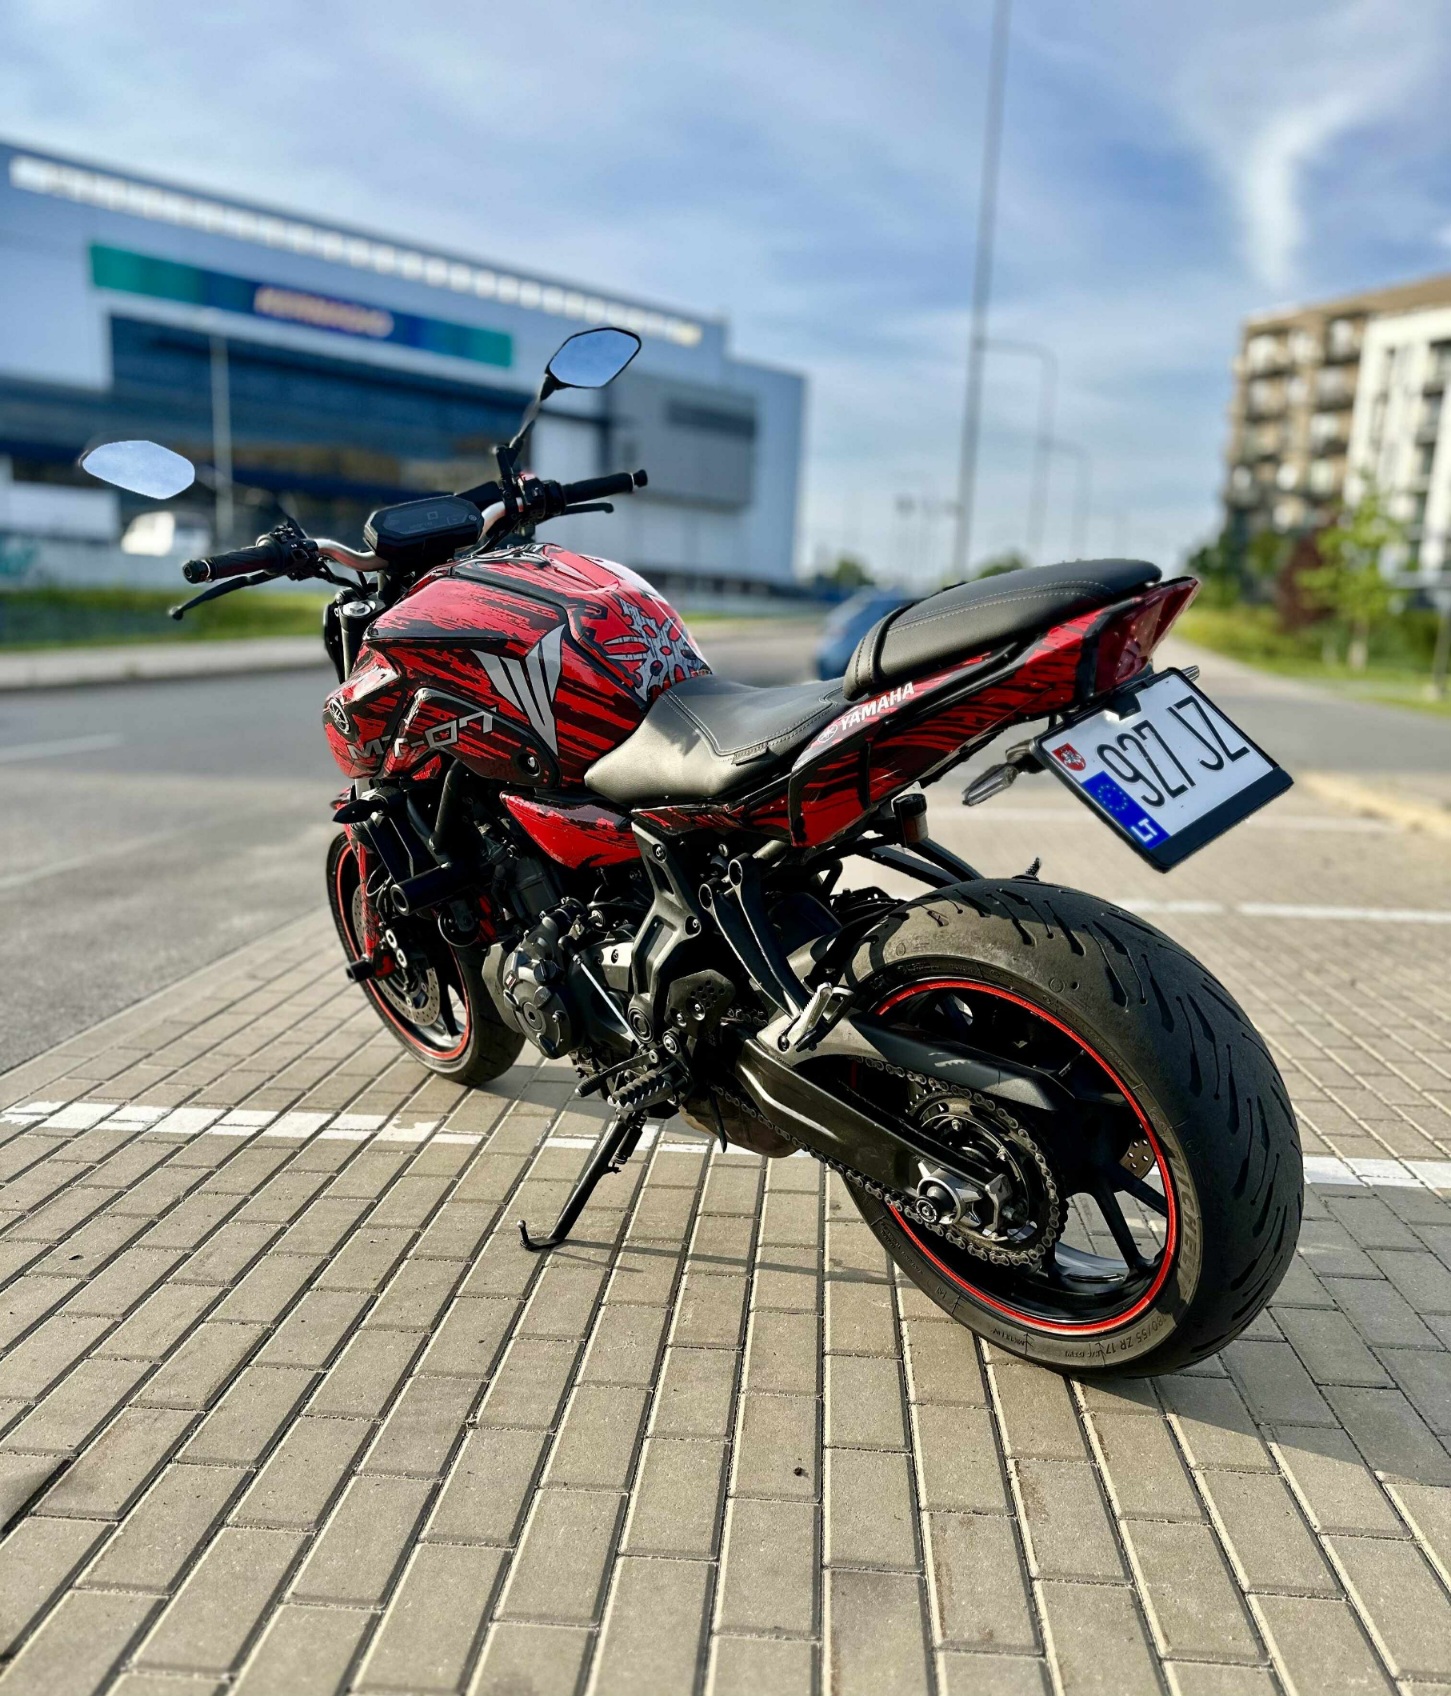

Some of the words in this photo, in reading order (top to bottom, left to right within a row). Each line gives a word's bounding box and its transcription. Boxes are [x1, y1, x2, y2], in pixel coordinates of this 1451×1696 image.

[840, 681, 915, 732] YAMAHA
[346, 706, 497, 760] MT-07
[1096, 719, 1196, 807] 927
[1166, 694, 1250, 771] JZ
[1131, 818, 1158, 843] LT
[1105, 1342, 1117, 1355] 17
[1120, 1336, 1134, 1351] ZR
